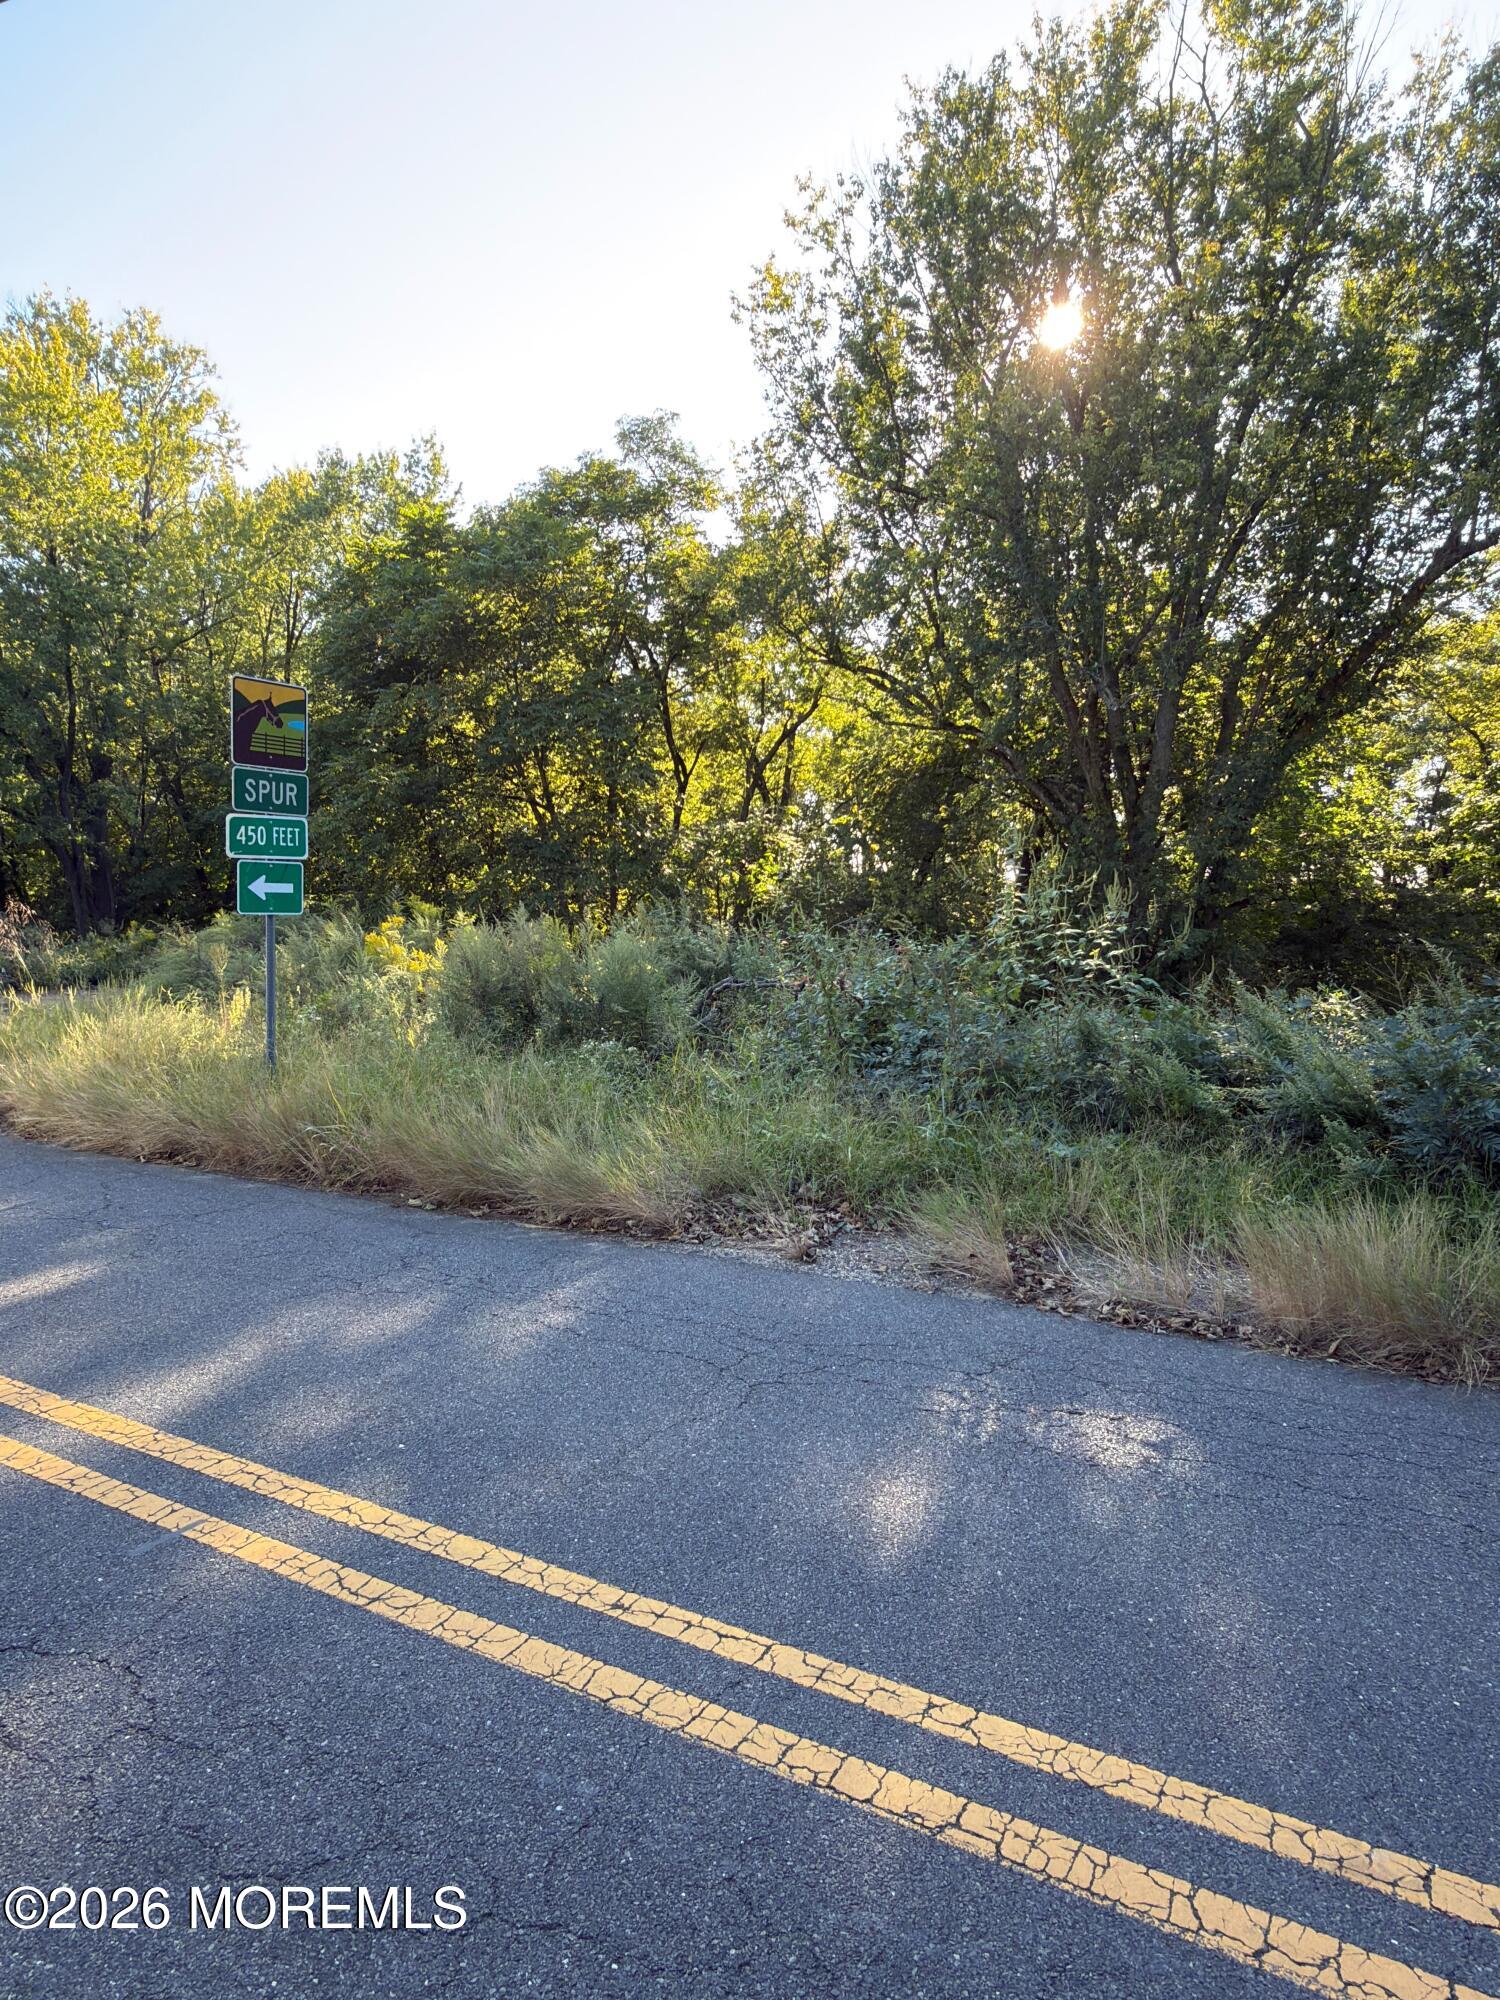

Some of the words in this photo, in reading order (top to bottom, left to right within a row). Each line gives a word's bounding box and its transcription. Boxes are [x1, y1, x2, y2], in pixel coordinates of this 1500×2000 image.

[244, 778, 298, 806] SPUR
[236, 825, 267, 846] 450
[272, 827, 300, 847] FEET
